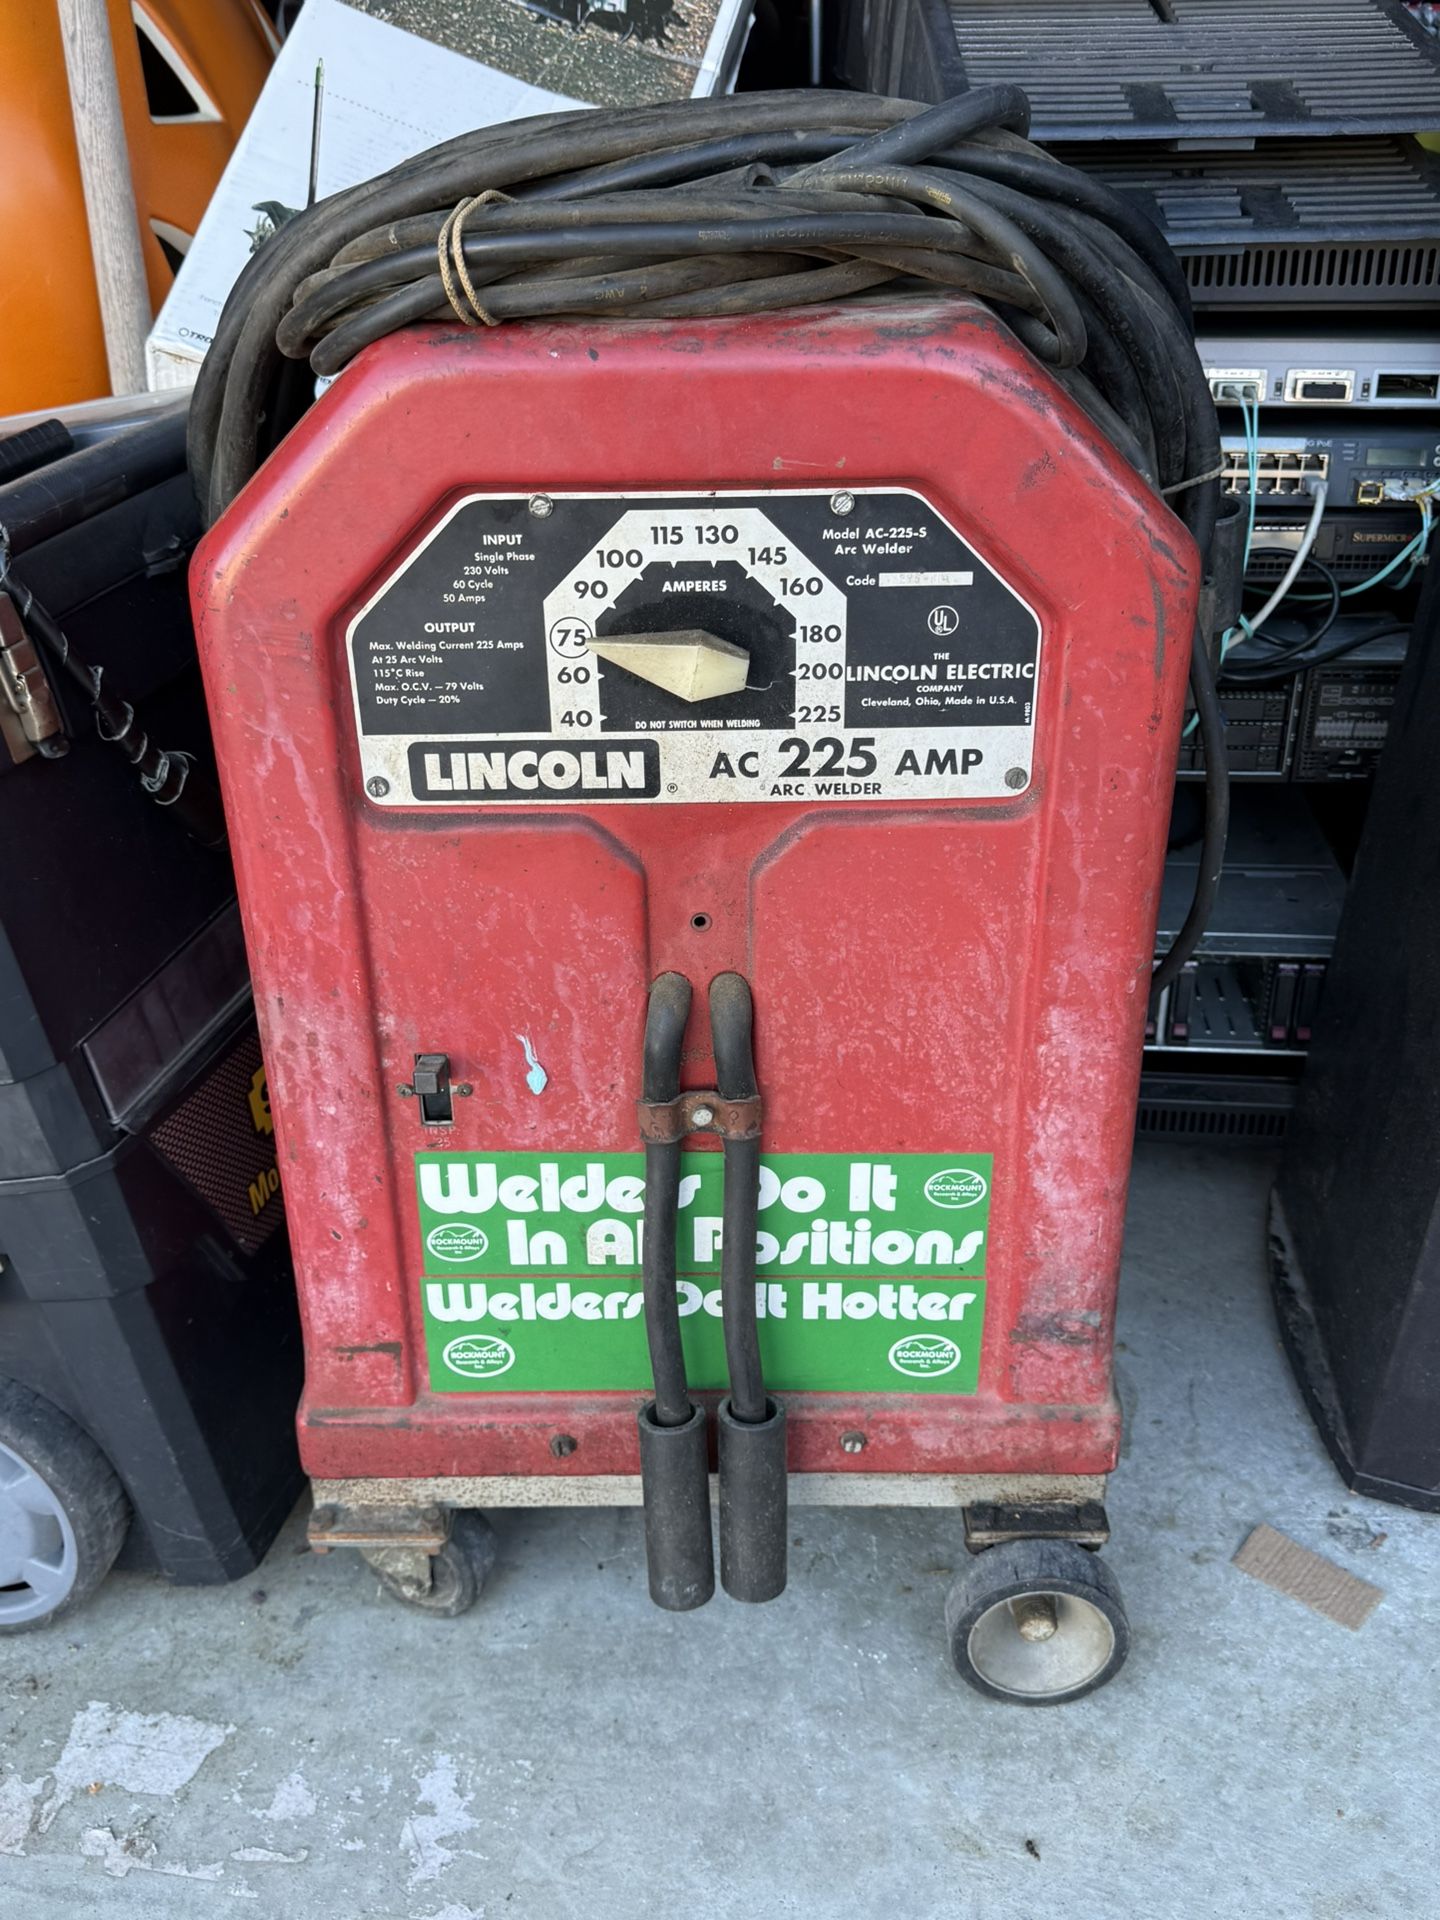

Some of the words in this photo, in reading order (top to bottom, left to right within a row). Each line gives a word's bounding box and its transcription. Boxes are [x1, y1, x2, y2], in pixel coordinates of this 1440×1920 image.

[483, 534, 523, 546] INPUT
[650, 526, 684, 545] 115
[695, 525, 739, 544] 130
[822, 528, 860, 540] Model
[865, 526, 927, 540] AC-225-S
[834, 544, 857, 555] Arc
[863, 543, 913, 555] Welder
[474, 552, 504, 563] Single
[507, 552, 535, 562] Phase
[596, 549, 643, 569] 100
[748, 547, 787, 566] 145
[463, 566, 482, 576] 230
[484, 565, 509, 575] Volts
[453, 580, 465, 590] 60
[467, 579, 493, 592] Cycle
[662, 579, 727, 593] AMPERES
[780, 577, 823, 596] 160
[846, 575, 876, 587] Code
[574, 580, 609, 600] 90
[443, 593, 456, 603] 50
[458, 593, 486, 605] Amps
[424, 622, 476, 634] OUTPUT
[800, 624, 842, 643] 180
[557, 629, 587, 647] 75
[369, 641, 394, 651] Max.
[396, 640, 437, 652] Welding
[439, 640, 474, 650] Current
[476, 640, 494, 650] 225
[496, 639, 524, 652] Amps
[372, 655, 383, 664] At
[385, 655, 398, 664] 25
[400, 655, 417, 664] Arc
[419, 654, 443, 664] Volts
[933, 652, 950, 661] THE
[405, 668, 425, 678] Rise
[557, 666, 591, 684] 60
[798, 663, 843, 681] 200
[846, 665, 937, 682] LINCOLN
[946, 663, 1034, 680] ELECTRIC
[375, 682, 399, 692] Max.
[401, 682, 432, 692] O.C.V.
[445, 682, 458, 691] 79
[460, 682, 484, 691] Volts
[916, 684, 963, 693] COMPANY
[376, 695, 399, 706] Duty
[401, 695, 426, 706] Cycle
[438, 694, 460, 704] 20%
[861, 696, 912, 708] Cleveland,
[915, 696, 941, 708] Ohio,
[944, 695, 973, 706] Made
[975, 695, 986, 705] in
[989, 695, 1017, 705] U.S.A.
[560, 710, 593, 728] 40
[798, 706, 841, 723] 225
[635, 721, 648, 730] DO
[650, 720, 666, 729] NOT
[668, 720, 697, 729] SWITCH
[700, 719, 723, 728] WHEN
[726, 719, 761, 728] WELDING
[709, 751, 760, 779] AC
[778, 736, 878, 778] 225
[895, 748, 984, 776] AMP
[424, 750, 646, 791] LINCOLN
[770, 783, 804, 796] ARC
[815, 782, 882, 795] WELDER
[419, 1163, 702, 1214] Weldes
[849, 1162, 898, 1212] It
[506, 1219, 568, 1265] In
[426, 1283, 644, 1322] Welders
[803, 1282, 977, 1321] Hotter
